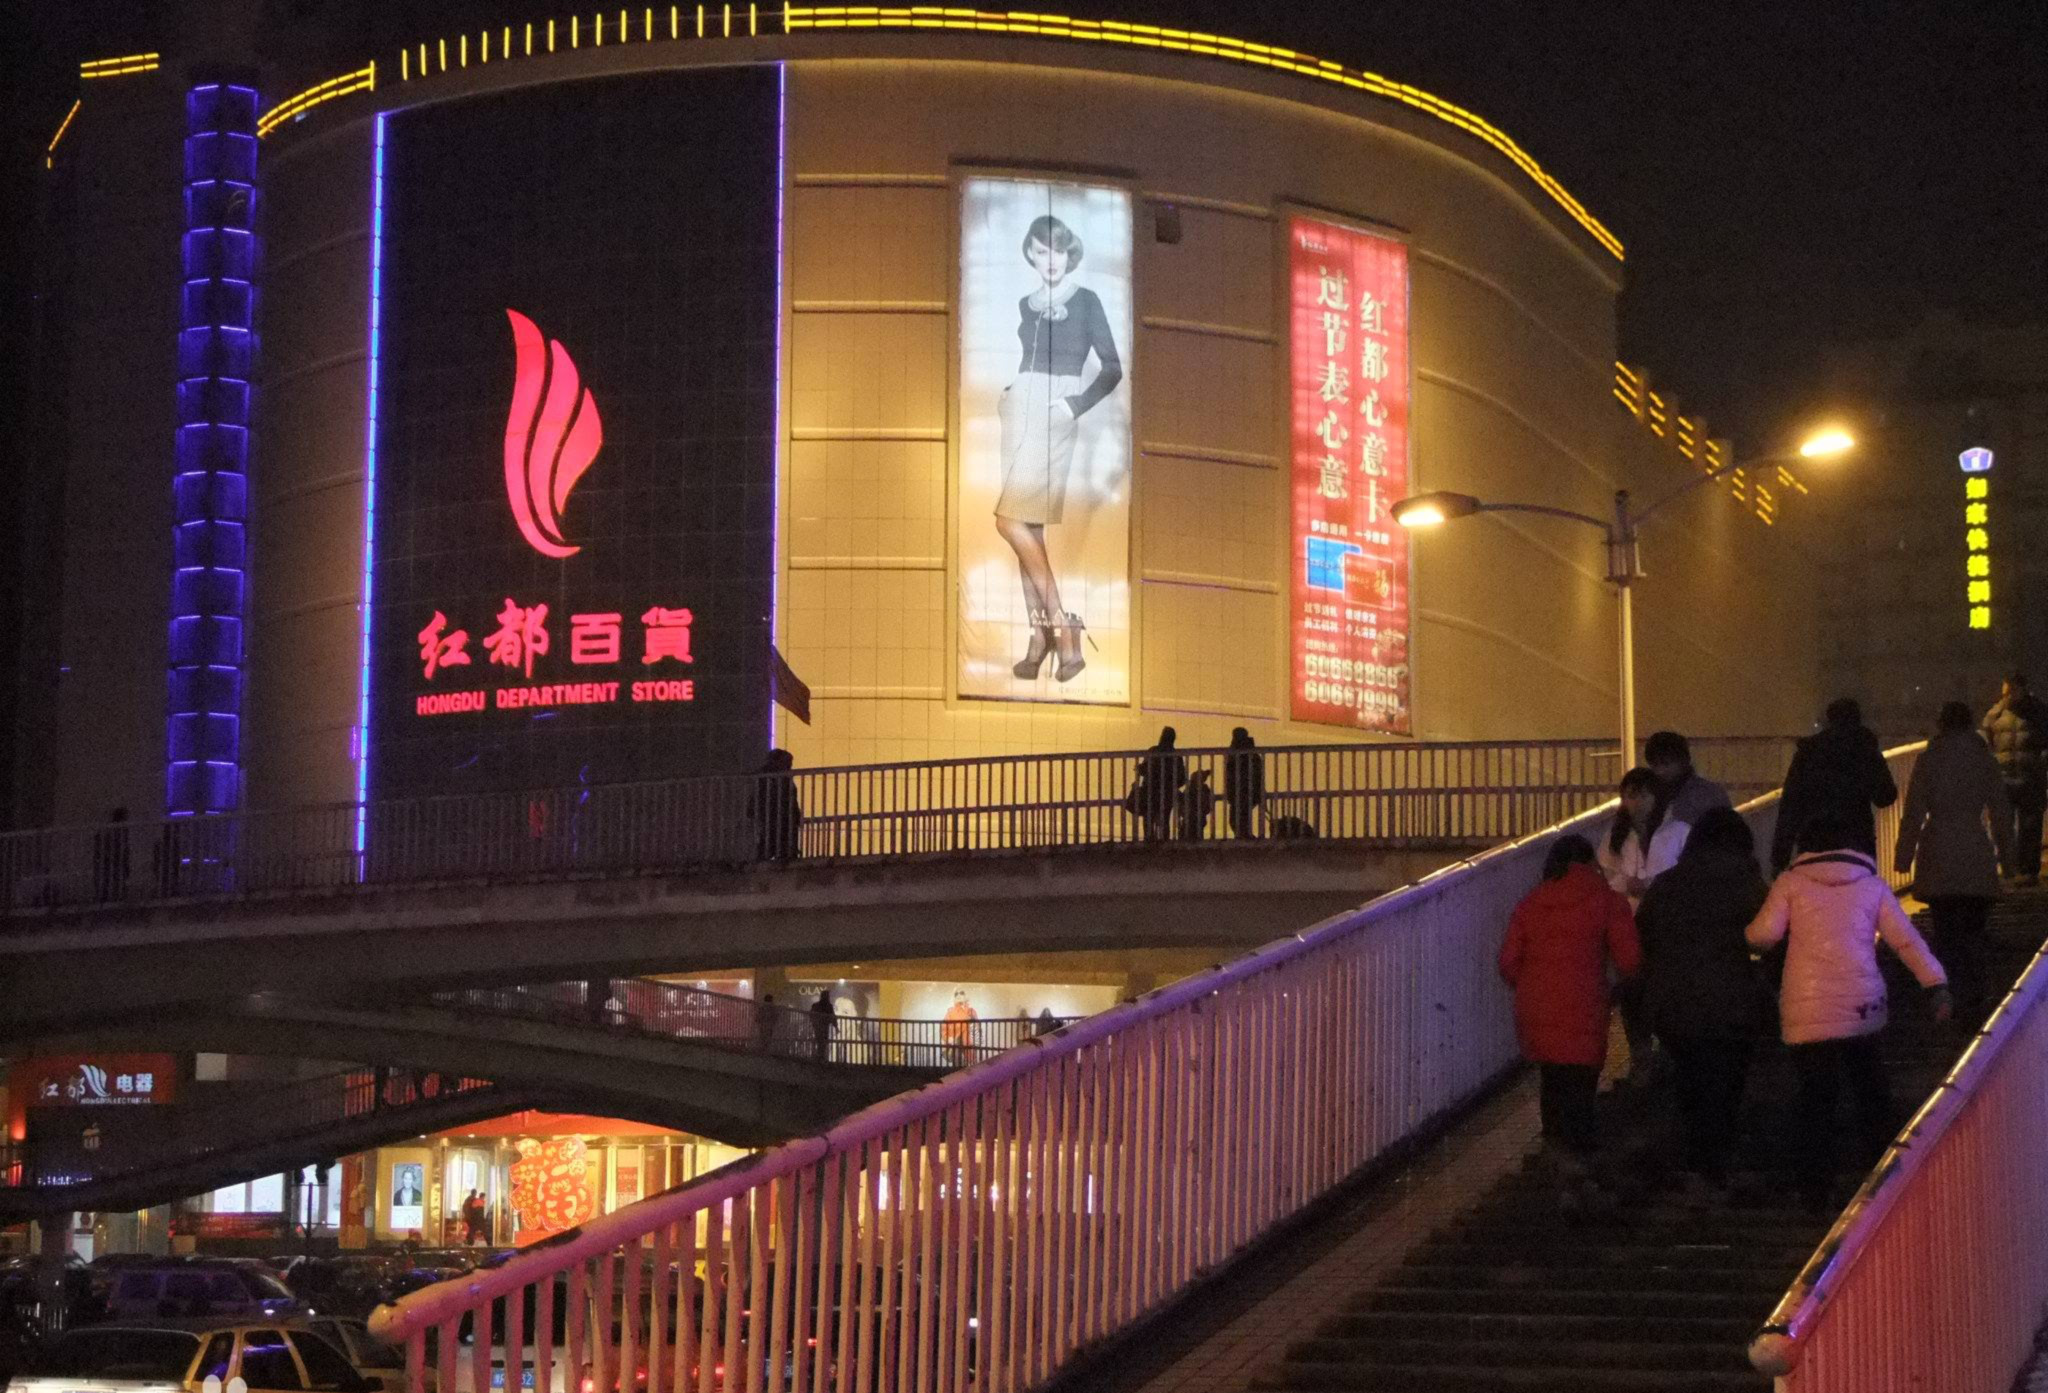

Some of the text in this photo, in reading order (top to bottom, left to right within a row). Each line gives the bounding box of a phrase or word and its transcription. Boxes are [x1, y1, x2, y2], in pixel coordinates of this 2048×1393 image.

[1315, 265, 1350, 499] 过节表心意
[1359, 291, 1389, 523] 红都心意卡
[417, 597, 694, 681] 红都百貨
[417, 680, 694, 715] HONGDU DEPARTMENT STORE
[1304, 679, 1400, 713] 60667999
[116, 1073, 153, 1092] 电器
